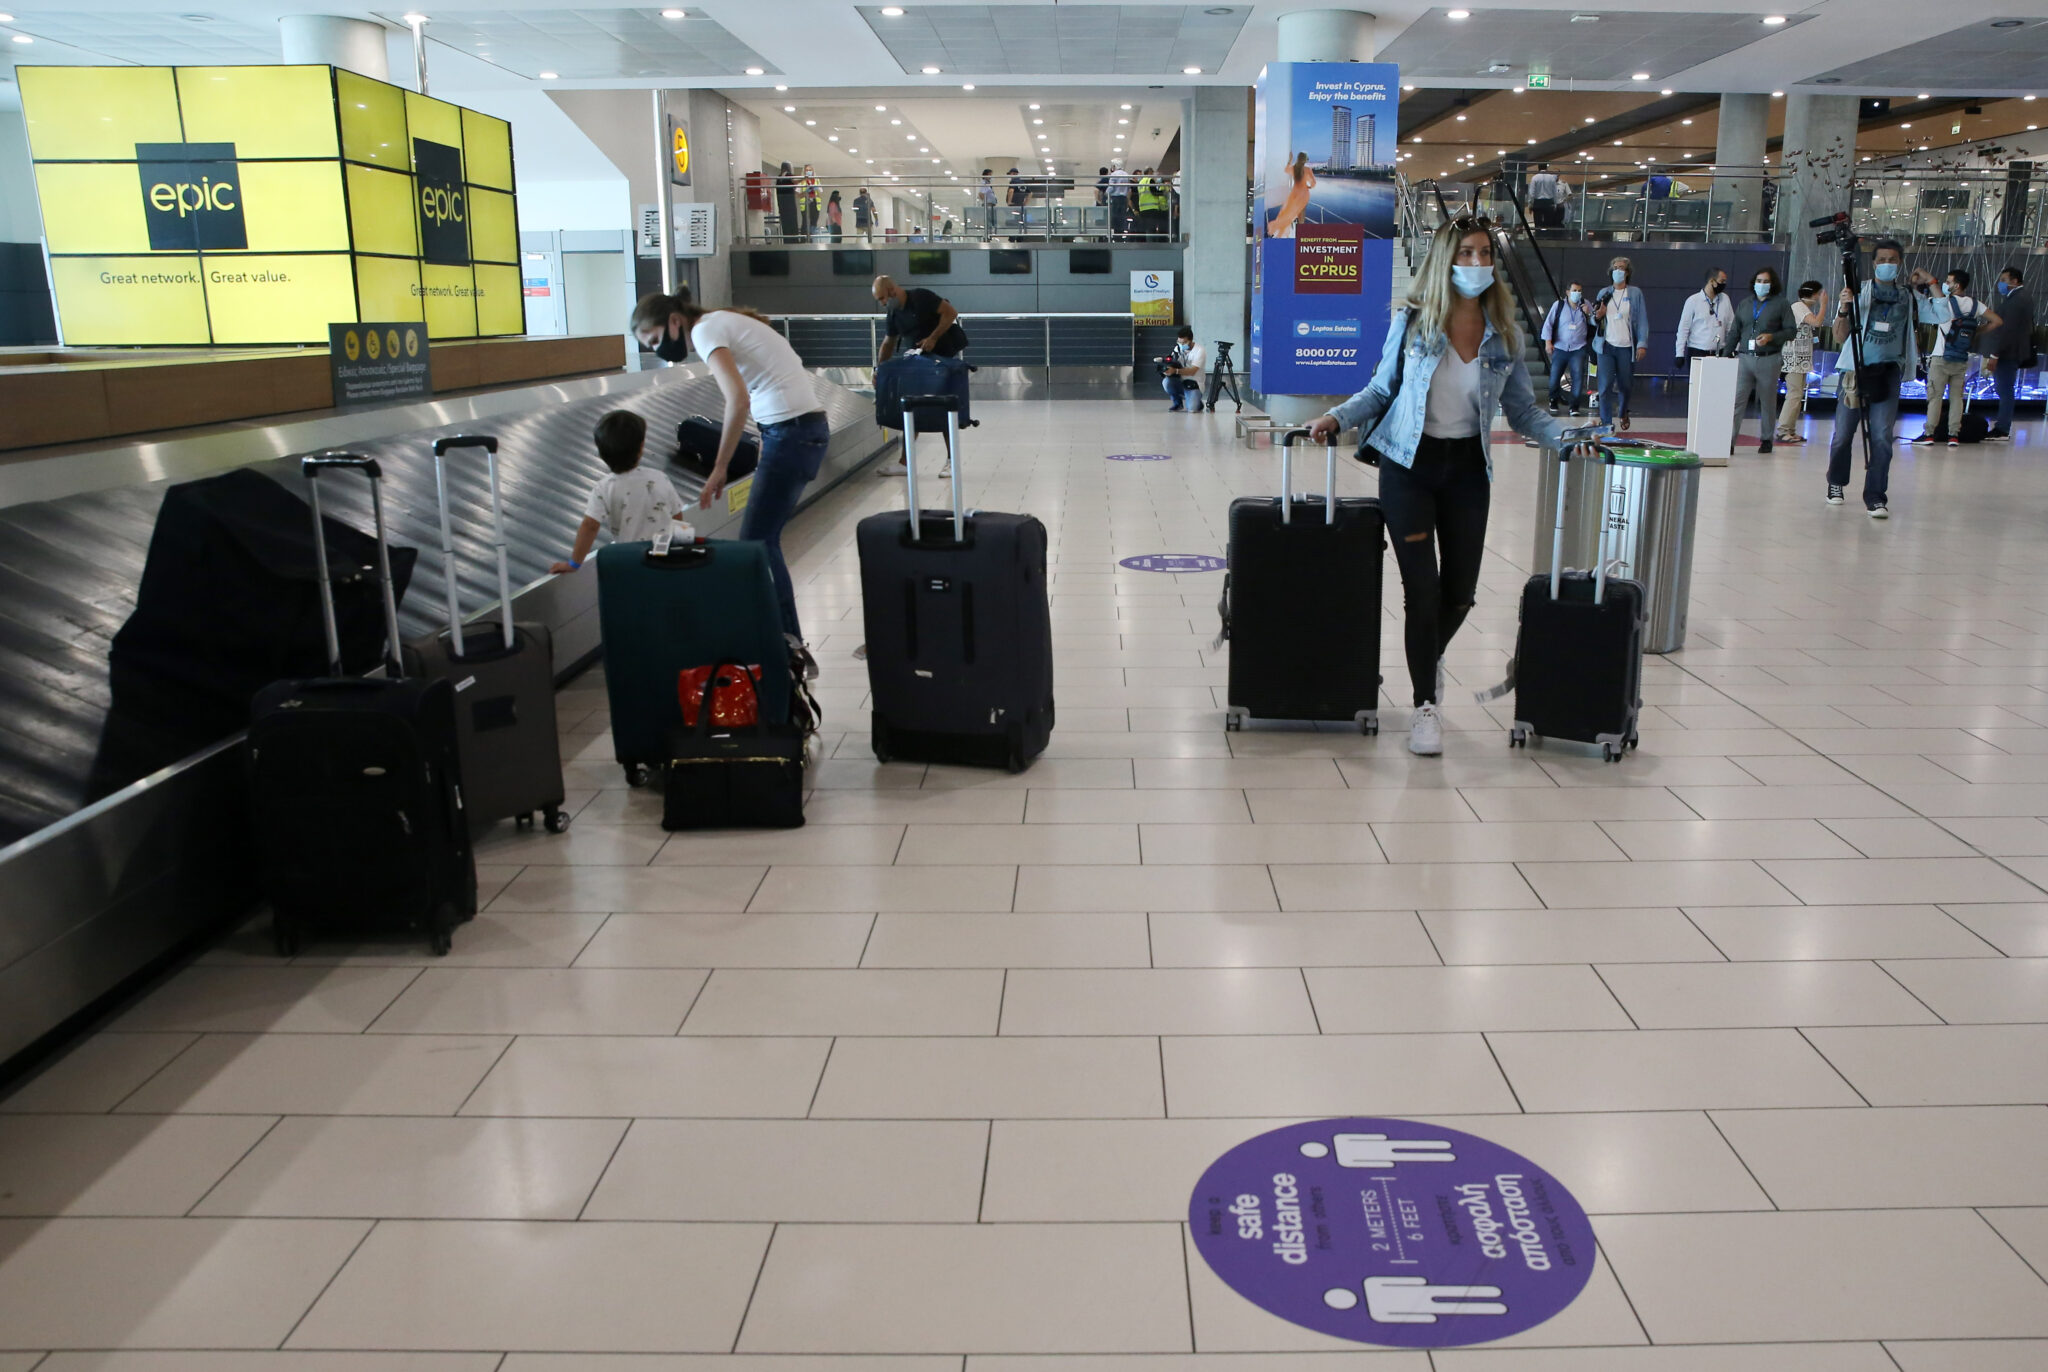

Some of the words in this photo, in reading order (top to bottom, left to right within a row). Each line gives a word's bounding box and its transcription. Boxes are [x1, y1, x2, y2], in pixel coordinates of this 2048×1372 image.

[1315, 81, 1343, 90] Invest
[1343, 81, 1352, 90] in
[1353, 81, 1386, 92] Cyprus.
[1308, 91, 1333, 102] Enjoy
[1334, 91, 1349, 100] the
[1350, 91, 1386, 101] benefits
[676, 133, 685, 168] 5
[150, 176, 236, 218] epic
[422, 183, 463, 227] epic
[1300, 245, 1358, 254] INVESTMENT
[1324, 255, 1334, 263] IN
[100, 272, 138, 284] Great
[141, 271, 200, 284] network.
[210, 271, 248, 284] Great
[251, 270, 291, 283] value.
[1299, 264, 1358, 276] CYPRUS
[410, 283, 428, 297] Great
[454, 284, 469, 297] Great
[1312, 325, 1334, 333] Leptos
[1295, 348, 1325, 357] 8000
[1326, 348, 1341, 357] 07
[1342, 348, 1358, 357] 07
[1228, 1194, 1263, 1239] safe
[1272, 1173, 1308, 1265] distance
[1361, 1190, 1388, 1238] METERS
[1398, 1198, 1421, 1229] FEET
[1454, 1184, 1507, 1259] ασφαλή
[1495, 1174, 1552, 1271] απόσταση
[1406, 1232, 1424, 1241] 6
[1372, 1241, 1390, 1251] 2
